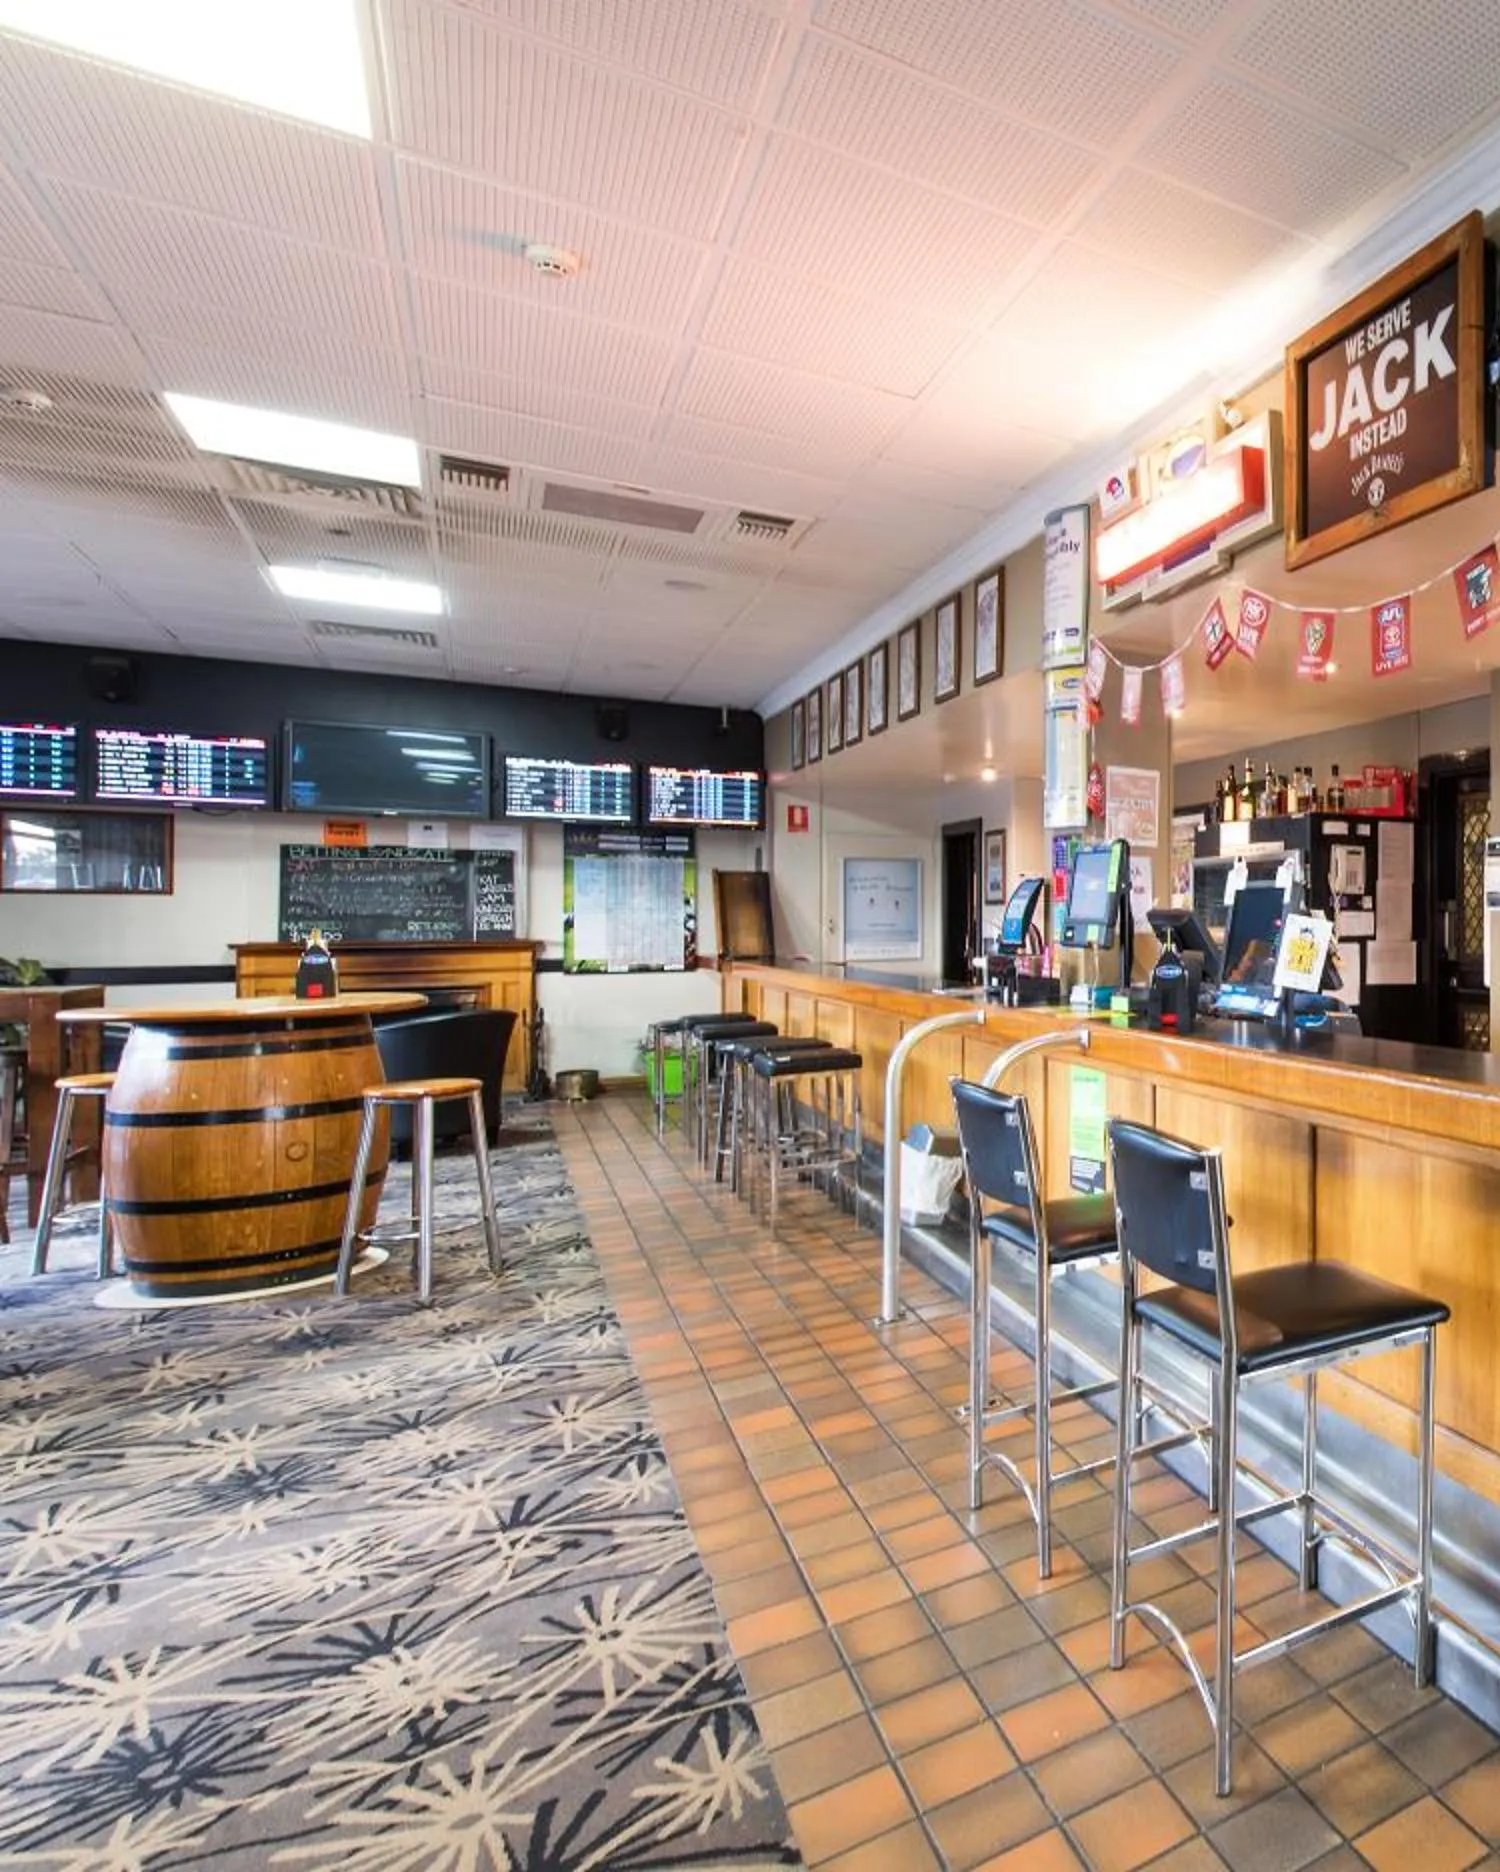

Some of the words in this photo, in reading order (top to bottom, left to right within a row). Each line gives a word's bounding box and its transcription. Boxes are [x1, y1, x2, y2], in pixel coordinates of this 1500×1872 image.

[1345, 329, 1365, 365] WE
[1367, 297, 1411, 352] SERVE
[1309, 303, 1457, 451] JACK
[1350, 407, 1408, 461] INSTEAD
